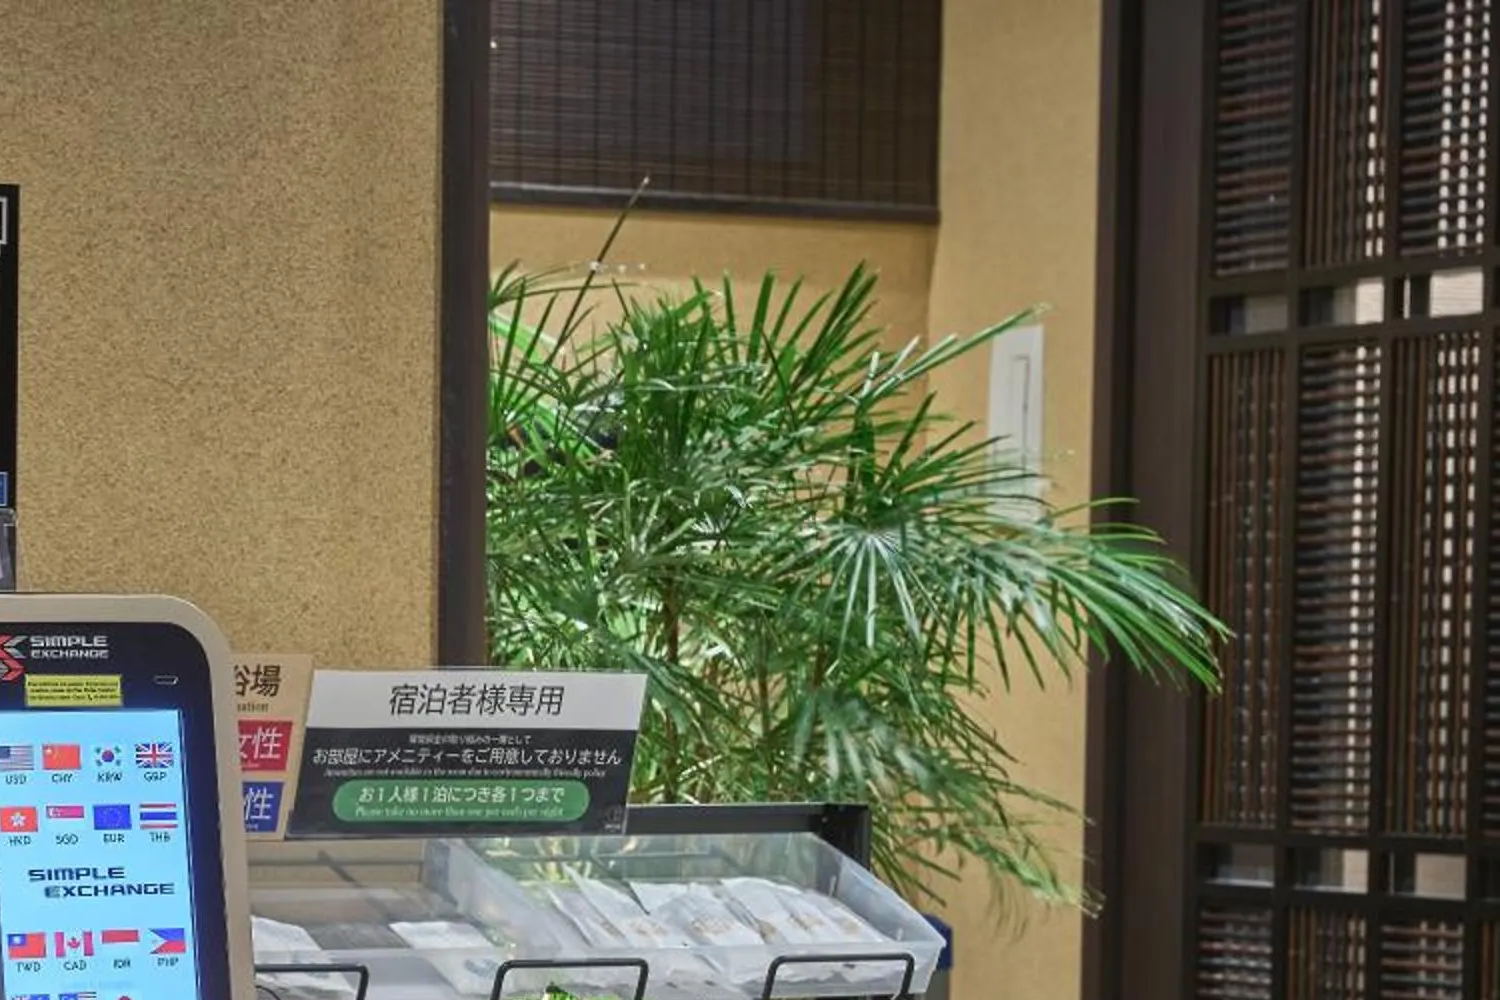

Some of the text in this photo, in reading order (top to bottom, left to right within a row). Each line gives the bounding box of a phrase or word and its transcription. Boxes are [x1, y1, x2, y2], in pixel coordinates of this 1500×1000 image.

[29, 635, 108, 647] SIMPLE
[30, 649, 110, 659] EXCHANGE
[389, 683, 565, 717] 宿泊者様専用
[312, 747, 622, 766] お部屋にアメニティーをご用意しておりません
[5, 773, 27, 785] USD
[244, 787, 274, 821] 性
[103, 833, 125, 844] EUR
[149, 832, 171, 842] THB
[28, 866, 126, 882] SIMPLE
[43, 882, 176, 898] EXCHANGE
[17, 961, 41, 972] TWD
[63, 960, 87, 971] CAD
